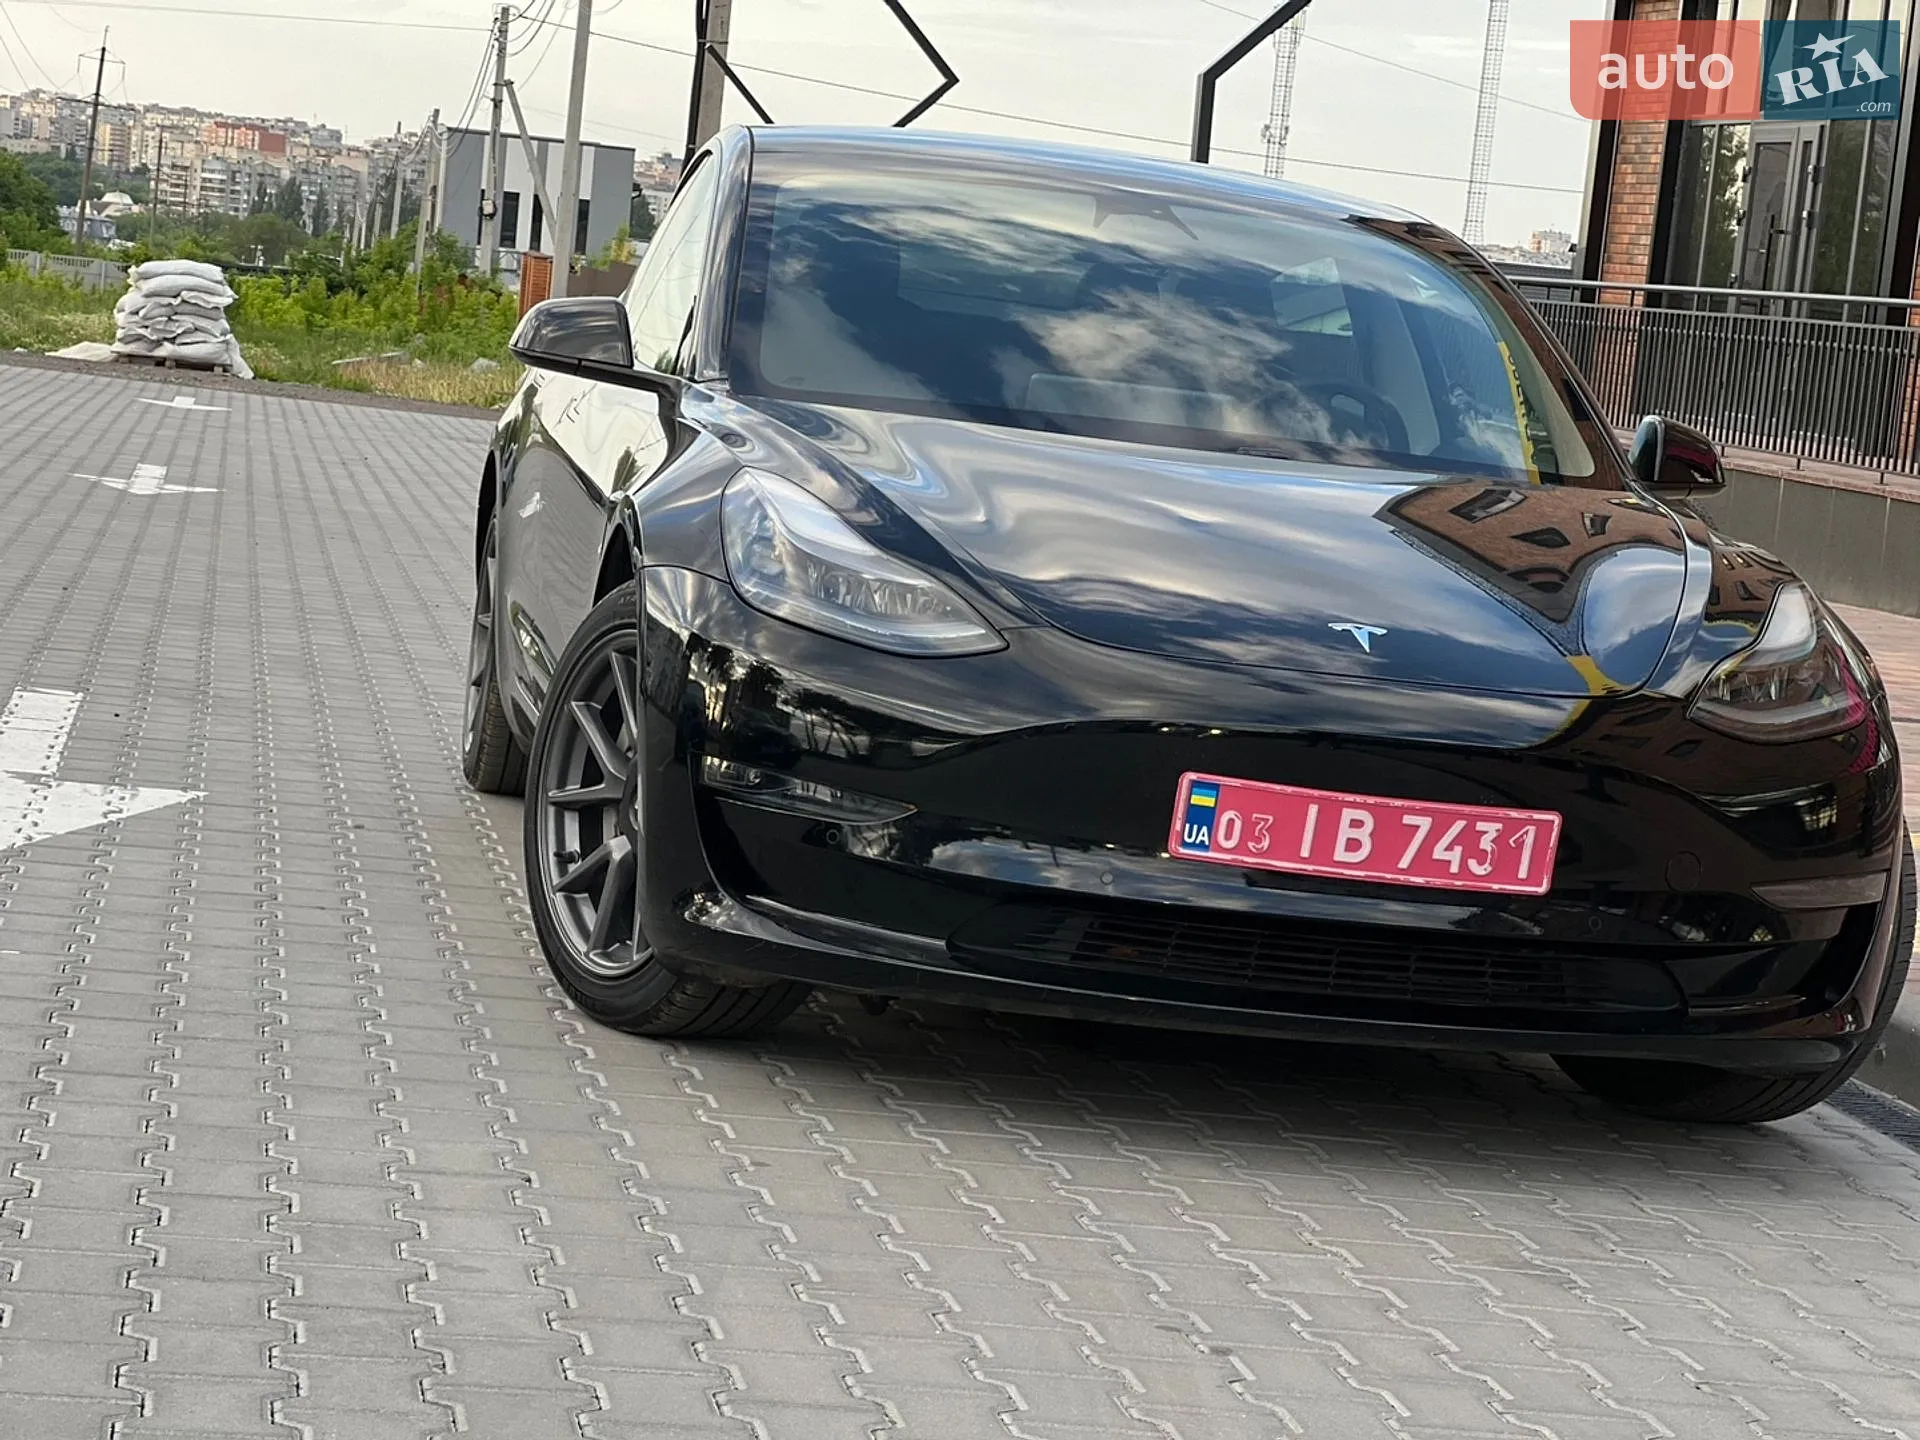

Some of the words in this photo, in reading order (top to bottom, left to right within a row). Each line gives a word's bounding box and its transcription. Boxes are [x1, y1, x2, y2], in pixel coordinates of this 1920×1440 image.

[1183, 823, 1209, 846] UA
[1217, 810, 1274, 854] 03
[1397, 815, 1537, 880] 7431
